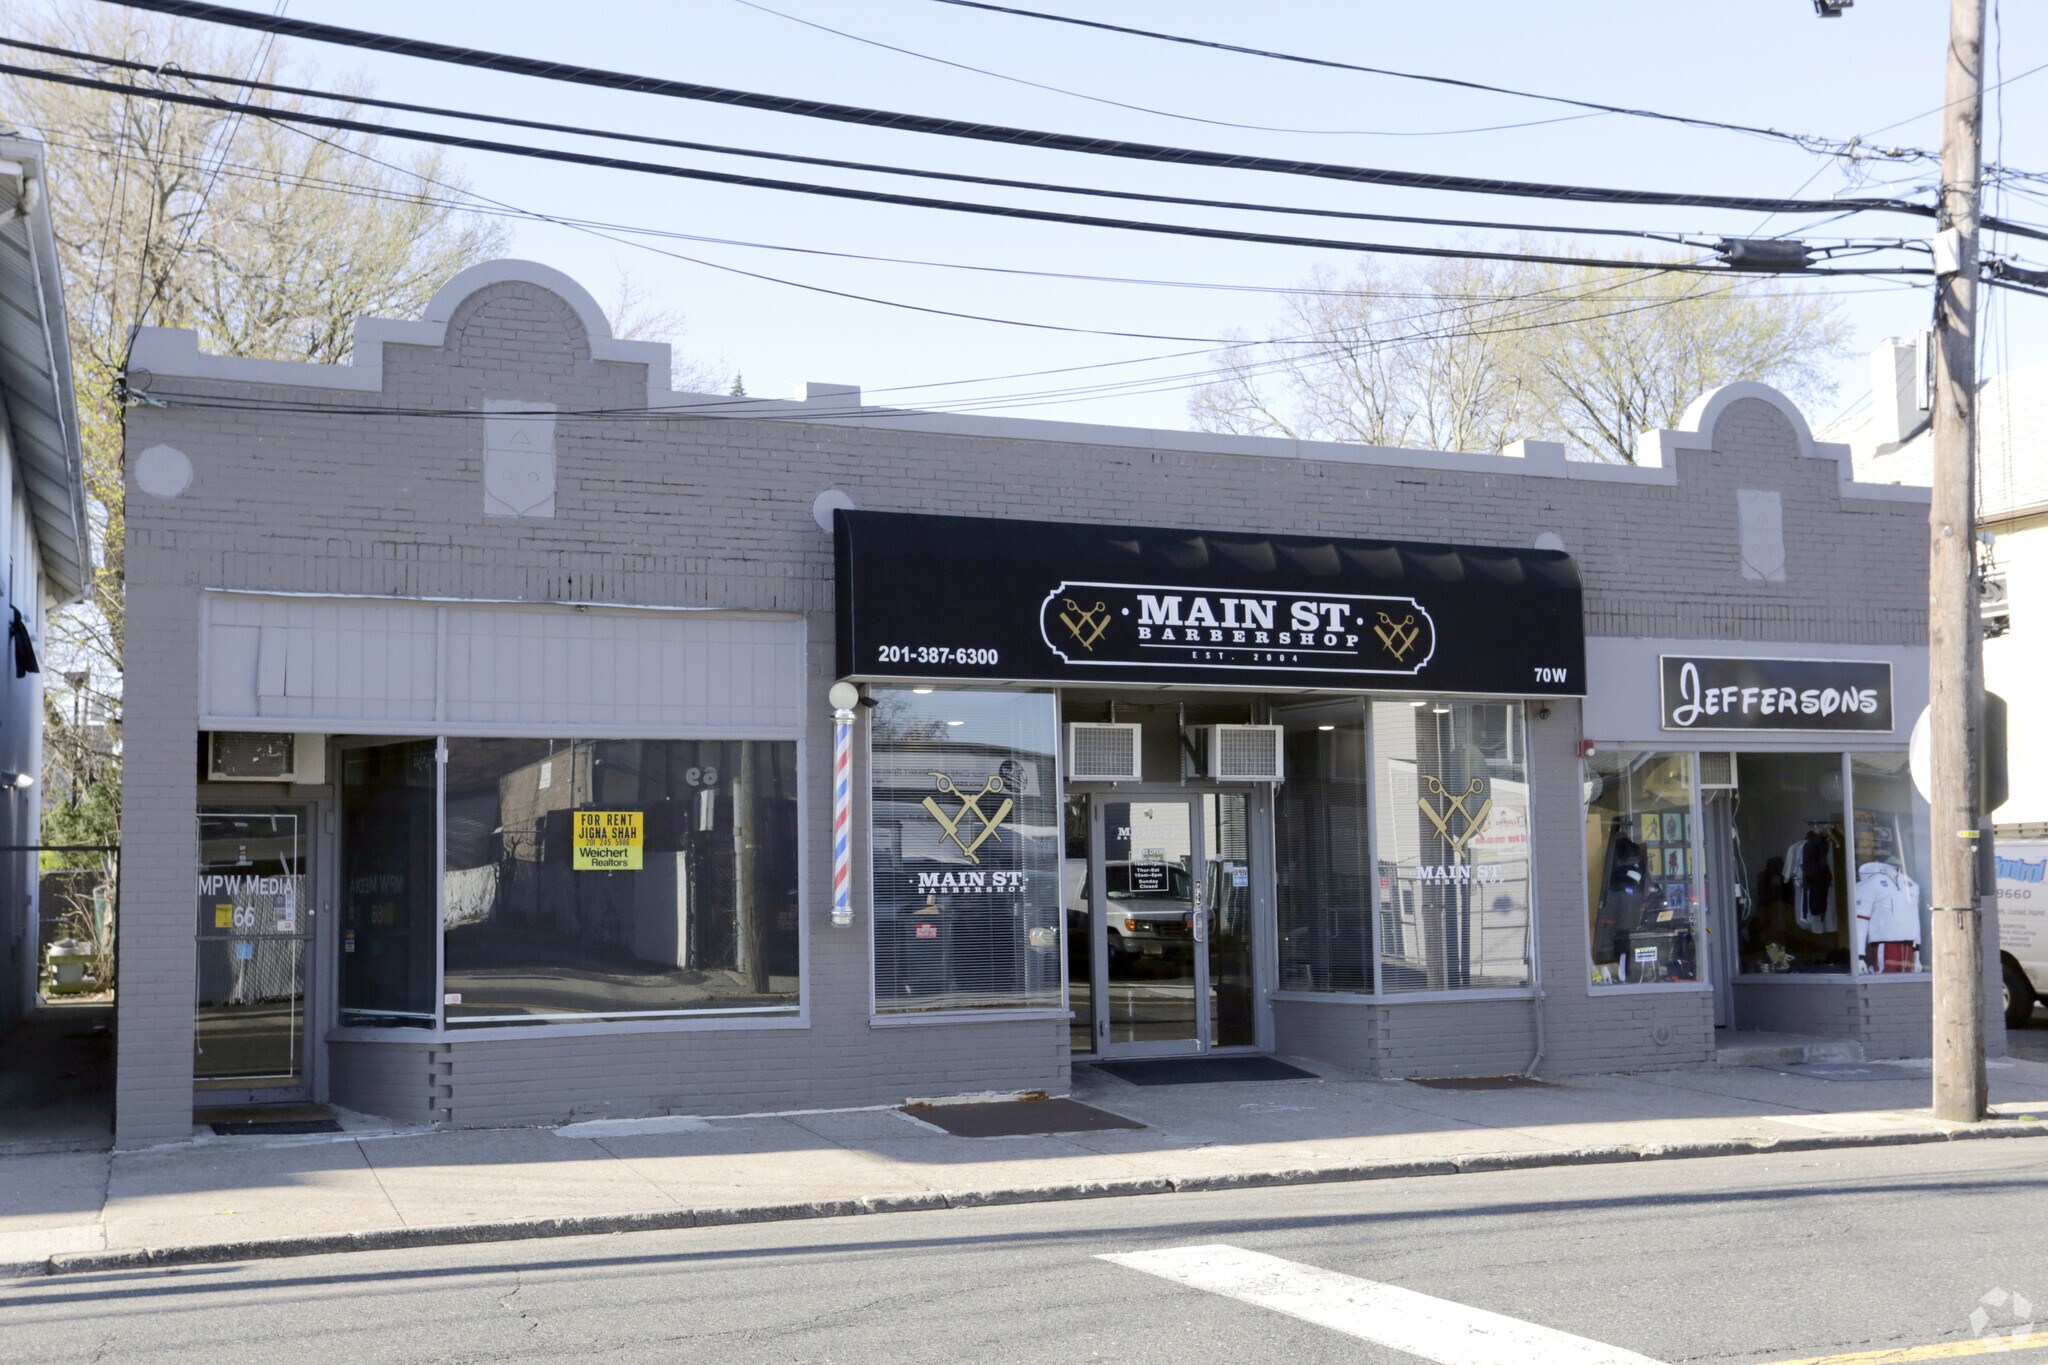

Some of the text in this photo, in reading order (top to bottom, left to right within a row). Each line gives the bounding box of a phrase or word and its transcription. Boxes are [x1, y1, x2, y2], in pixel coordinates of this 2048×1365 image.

[1137, 595, 1277, 629] MAIN
[1138, 627, 1359, 647] BARBERSHOP
[878, 645, 998, 665] 201-387-6300
[1192, 651, 1298, 662] EST. 2004
[1534, 667, 1567, 683] 70W
[581, 814, 633, 826] FOR RENT
[579, 827, 637, 839] JIGNA SHAH
[579, 847, 628, 858] Weichert
[591, 858, 628, 867] Realtors
[1416, 865, 1471, 879] MAIN
[199, 874, 241, 895] MPW
[918, 872, 986, 887] MAIN
[918, 886, 1026, 894] BARBERSHOP
[233, 906, 255, 926] 66
